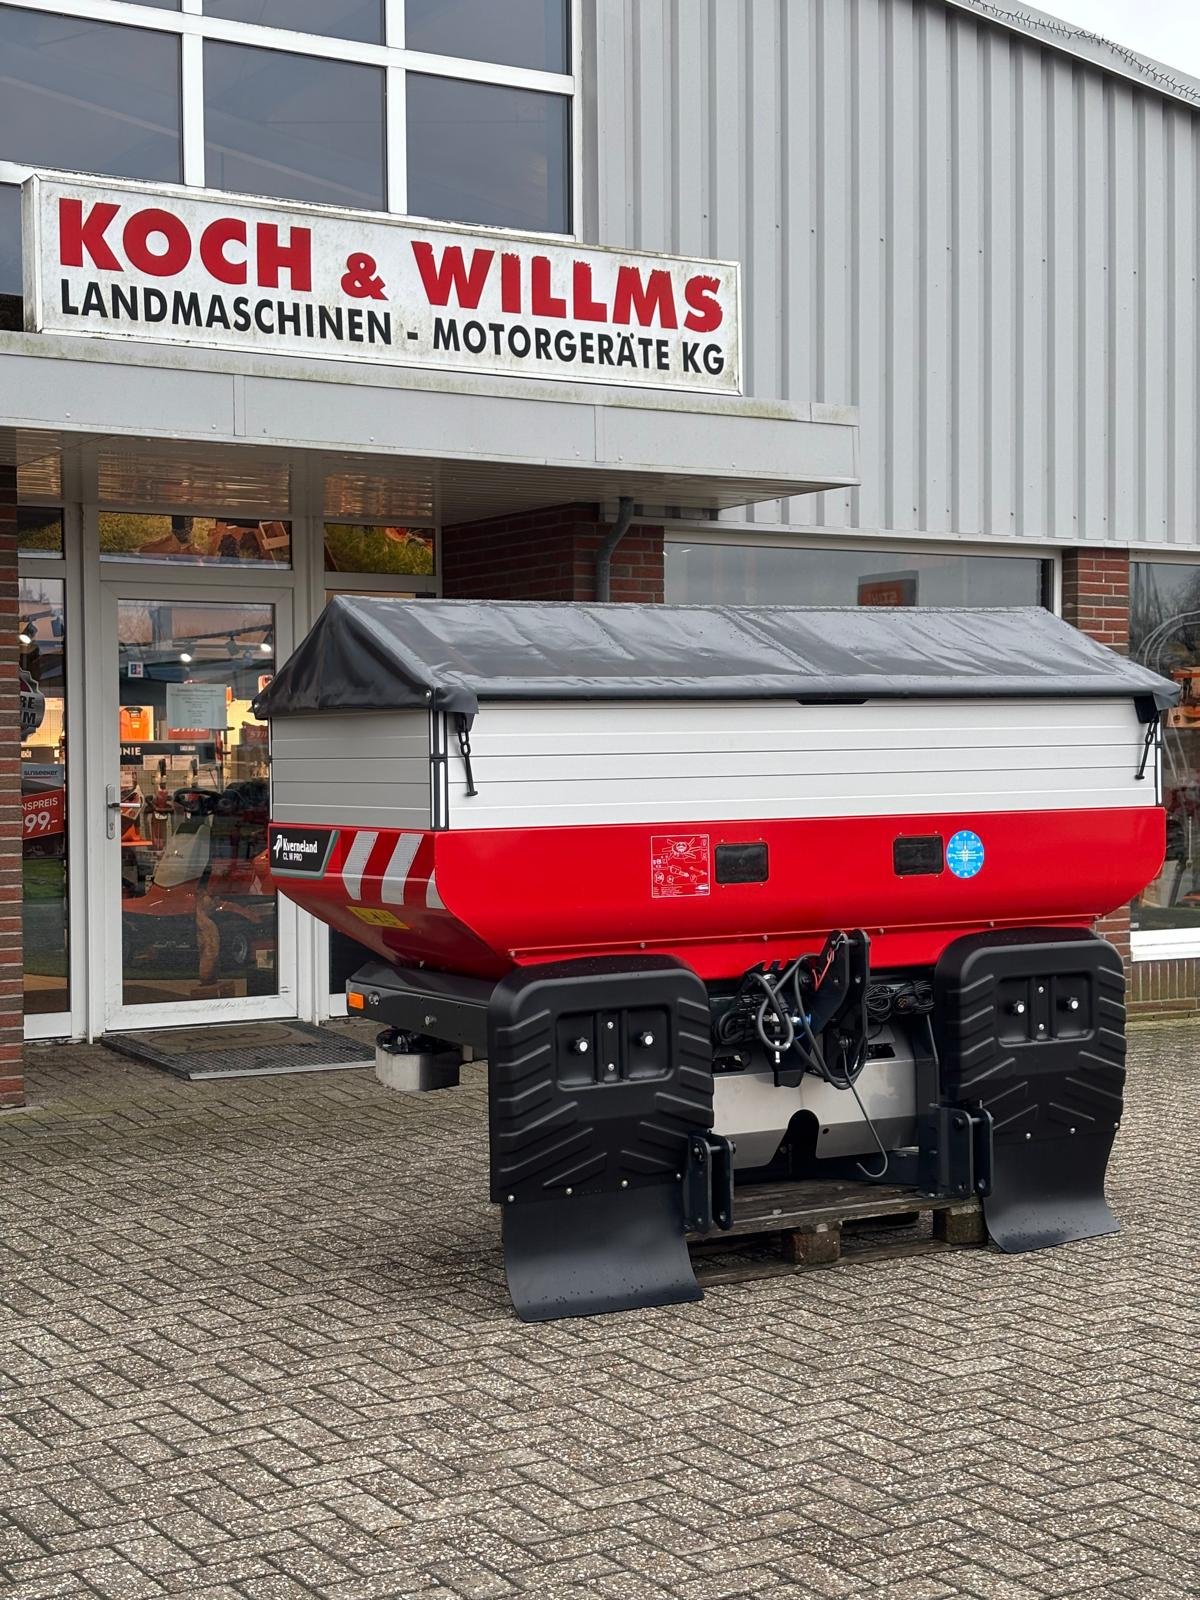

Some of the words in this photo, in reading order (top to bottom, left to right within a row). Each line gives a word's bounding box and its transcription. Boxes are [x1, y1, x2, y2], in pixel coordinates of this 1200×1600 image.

[60, 199, 312, 292] KOCH
[341, 253, 385, 300] &
[412, 241, 723, 333] WILLMS
[61, 278, 391, 345] LANDMASCHINEN
[433, 317, 670, 371] MOTORGERÄTE
[682, 341, 724, 376] KG
[283, 838, 318, 853] Kverneland
